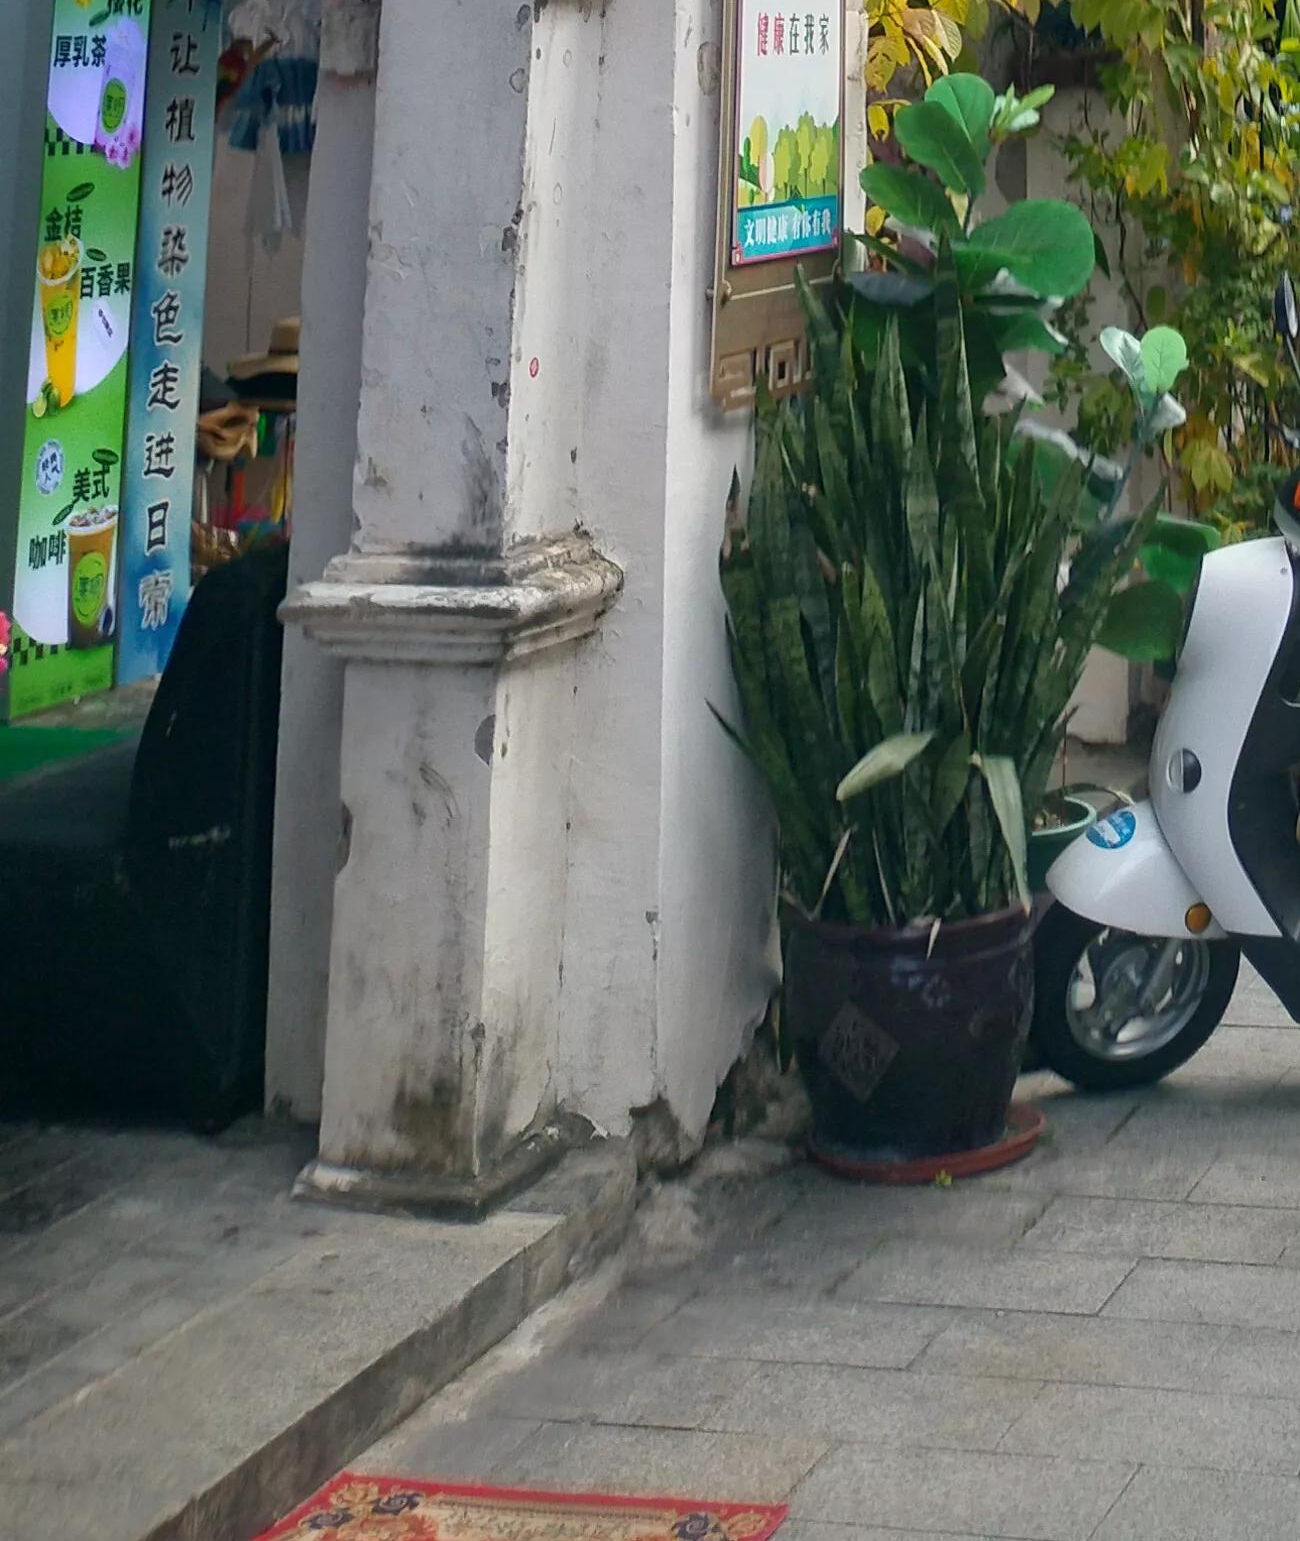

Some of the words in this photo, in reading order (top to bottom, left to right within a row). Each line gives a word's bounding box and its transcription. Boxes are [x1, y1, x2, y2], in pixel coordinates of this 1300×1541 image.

[54, 35, 107, 67] 厚乳茶
[757, 12, 830, 56] 健康在我家
[44, 204, 84, 242] 金桔
[744, 214, 788, 246] 文明健康
[80, 262, 131, 299] 百香果
[139, 31, 200, 630] 让植物染色走进日常
[73, 463, 110, 503] 美式
[29, 529, 66, 569] 咖啡
